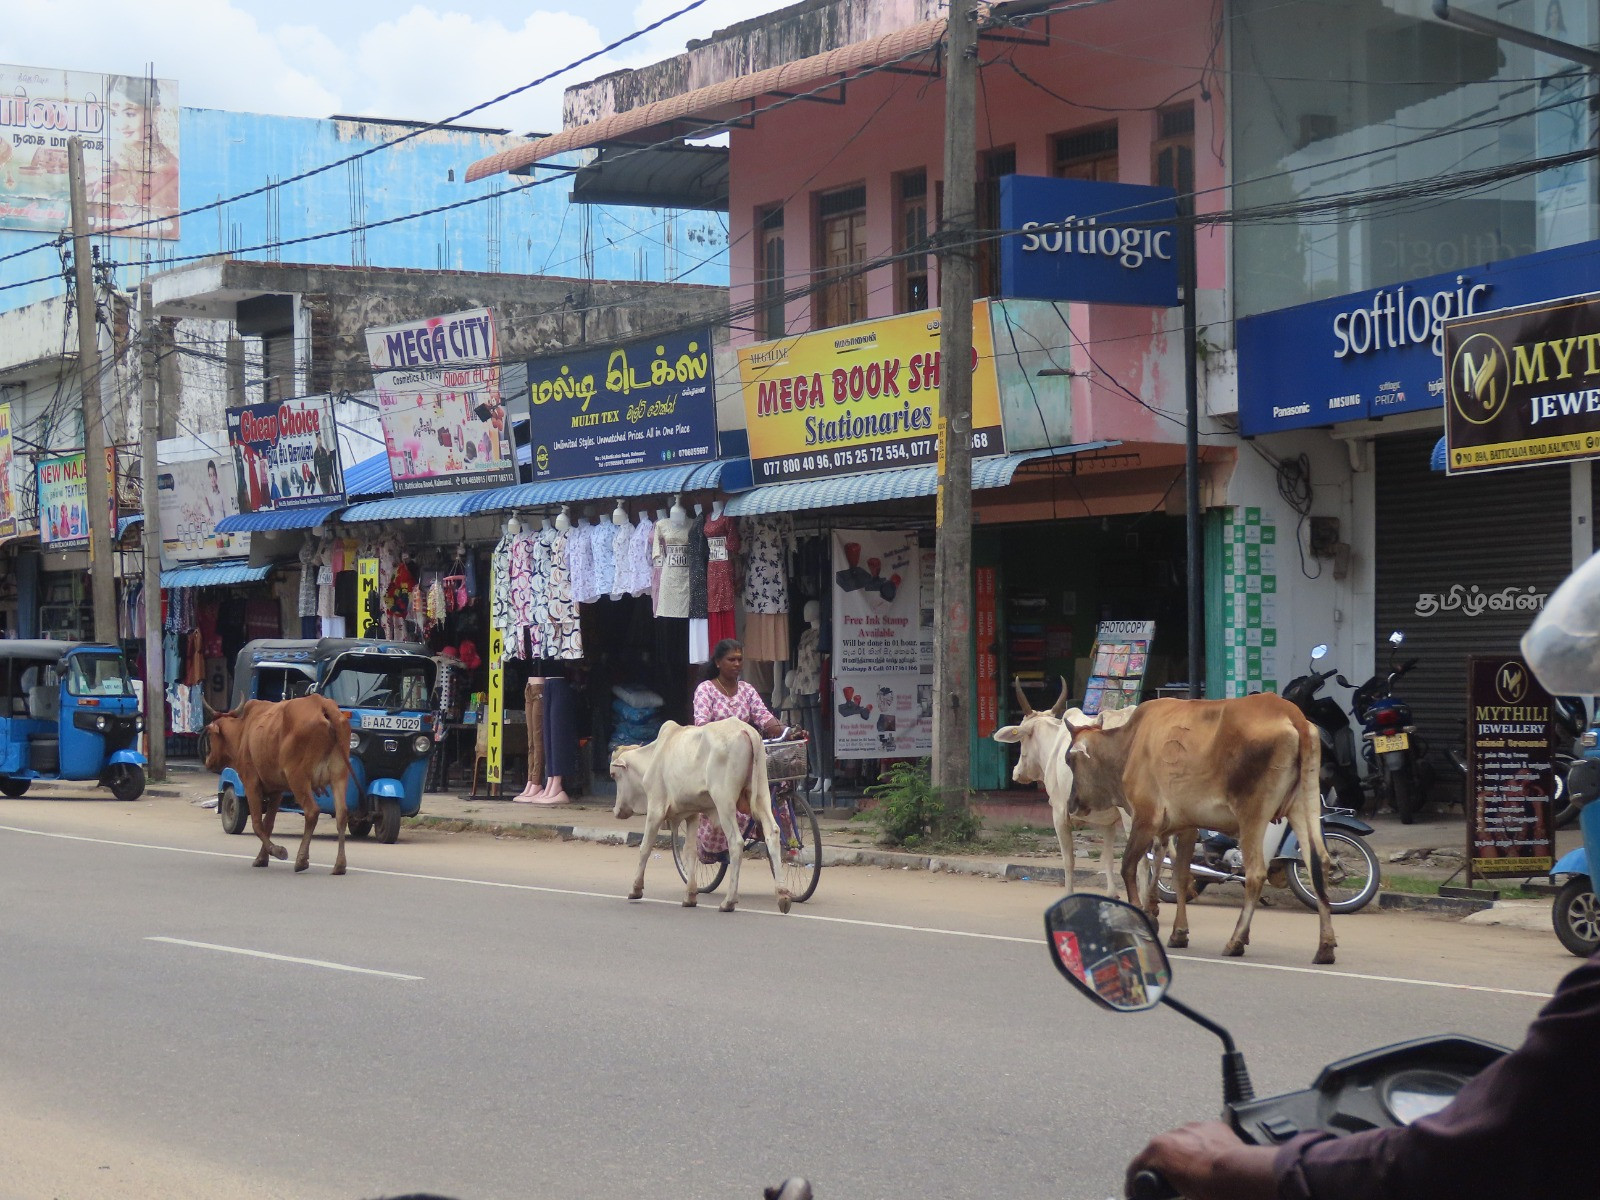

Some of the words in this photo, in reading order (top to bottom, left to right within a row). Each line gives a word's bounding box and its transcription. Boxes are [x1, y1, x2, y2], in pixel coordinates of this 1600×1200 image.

[13, 133, 45, 149] நகை
[1022, 214, 1172, 269] softlogic
[386, 325, 448, 366] MEGA
[449, 316, 490, 360] CITY
[750, 347, 789, 365] MEGALINE
[393, 373, 419, 386] Cosmetics
[532, 365, 597, 412] மல்டி
[605, 341, 708, 395] டெக்ஸ்
[758, 373, 824, 416] MEGA
[832, 358, 899, 404] BOOK
[908, 347, 978, 392] SH
[571, 413, 599, 428] MULTI
[601, 410, 620, 424] TEX
[1273, 402, 1311, 418] Panasonic
[241, 409, 278, 447] Cheap
[278, 401, 320, 440] Choice
[805, 401, 932, 446] Stationaries
[553, 437, 577, 451] Unlimited
[596, 432, 626, 446] Unmatched
[646, 427, 655, 439] All
[656, 426, 661, 437] in
[662, 426, 674, 437] One
[675, 424, 690, 435] Place
[763, 462, 781, 477] 077
[783, 459, 801, 474] 800
[802, 457, 815, 472] 40
[816, 455, 833, 472] 96,
[834, 449, 853, 468] 075
[855, 448, 868, 465] 25
[870, 446, 884, 463] 72
[886, 441, 910, 462] 554,
[911, 440, 930, 457] 077
[40, 463, 61, 485] NEW
[844, 615, 863, 625] Free
[866, 615, 880, 625] Ink
[882, 615, 909, 627] Stamp
[858, 628, 895, 638] Available
[842, 639, 856, 647] Will
[857, 639, 865, 647] be
[867, 639, 883, 647] done
[884, 639, 891, 647] in
[900, 639, 918, 647] hour.
[841, 665, 867, 673] Whatsapp
[491, 673, 499, 762] CITY
[1475, 705, 1549, 721] MYTHILI
[373, 717, 392, 729] AAZ
[396, 718, 420, 731] 9029
[1478, 724, 1546, 735] JEWELLERY
